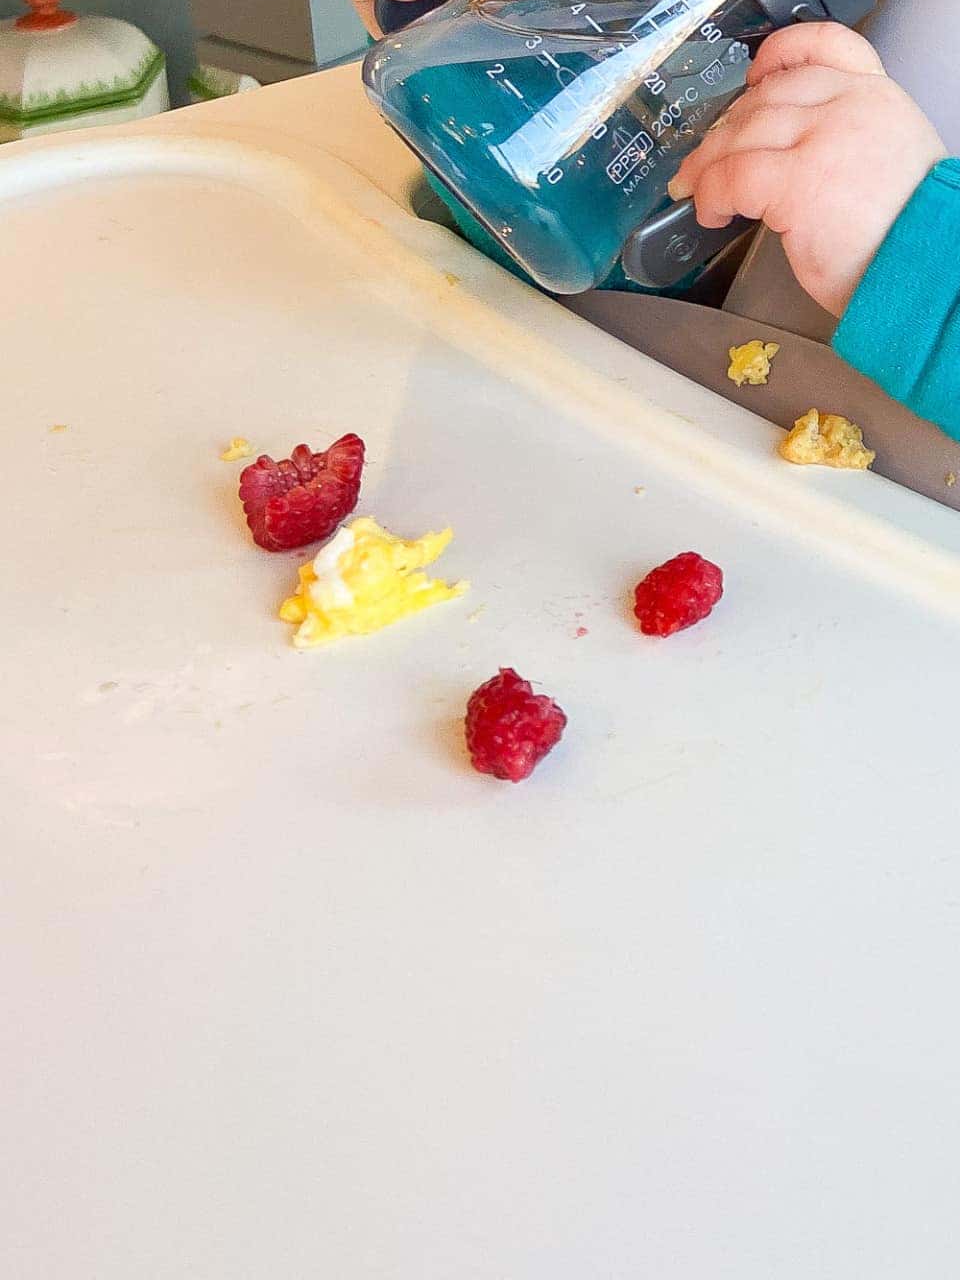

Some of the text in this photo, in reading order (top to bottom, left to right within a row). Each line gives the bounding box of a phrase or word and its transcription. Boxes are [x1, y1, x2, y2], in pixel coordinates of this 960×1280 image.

[570, 3, 586, 16] 4
[525, 35, 543, 49] 3
[486, 63, 505, 79] 2
[623, 102, 713, 196] MADE IN KOREA
[611, 137, 649, 178] PPSU
